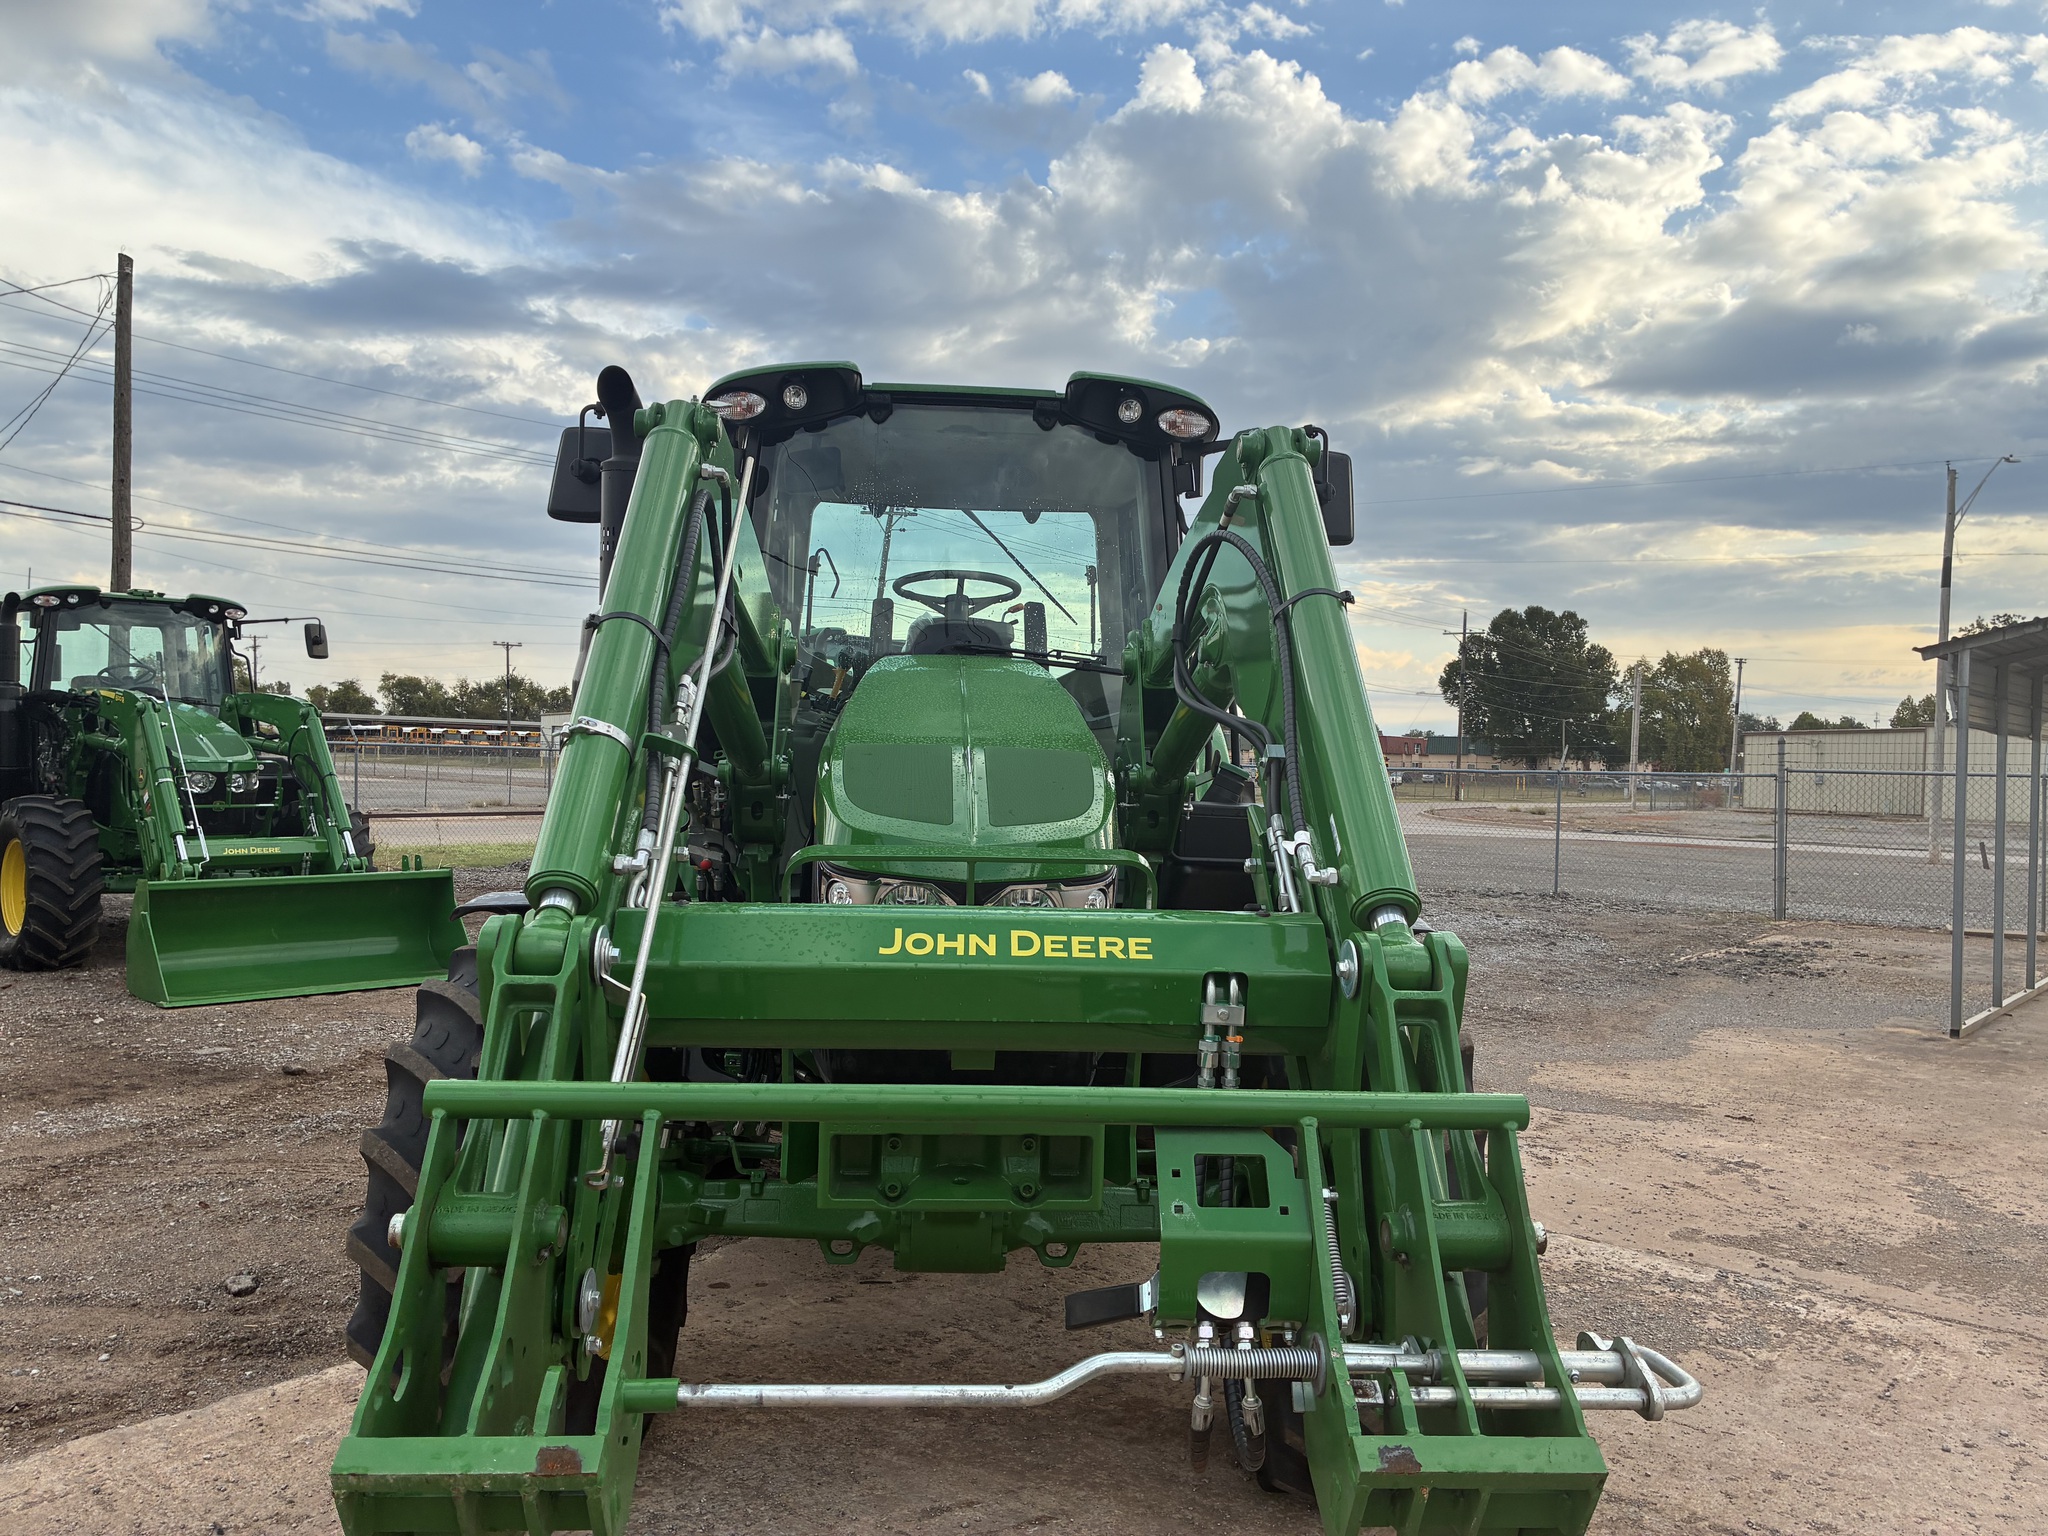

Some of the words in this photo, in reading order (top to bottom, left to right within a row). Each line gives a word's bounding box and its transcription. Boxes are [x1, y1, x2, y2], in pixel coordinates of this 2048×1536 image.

[223, 847, 248, 855] JOHN
[250, 846, 281, 854] DEERE
[878, 927, 996, 956] JOHN
[1010, 929, 1153, 960] DEERE
